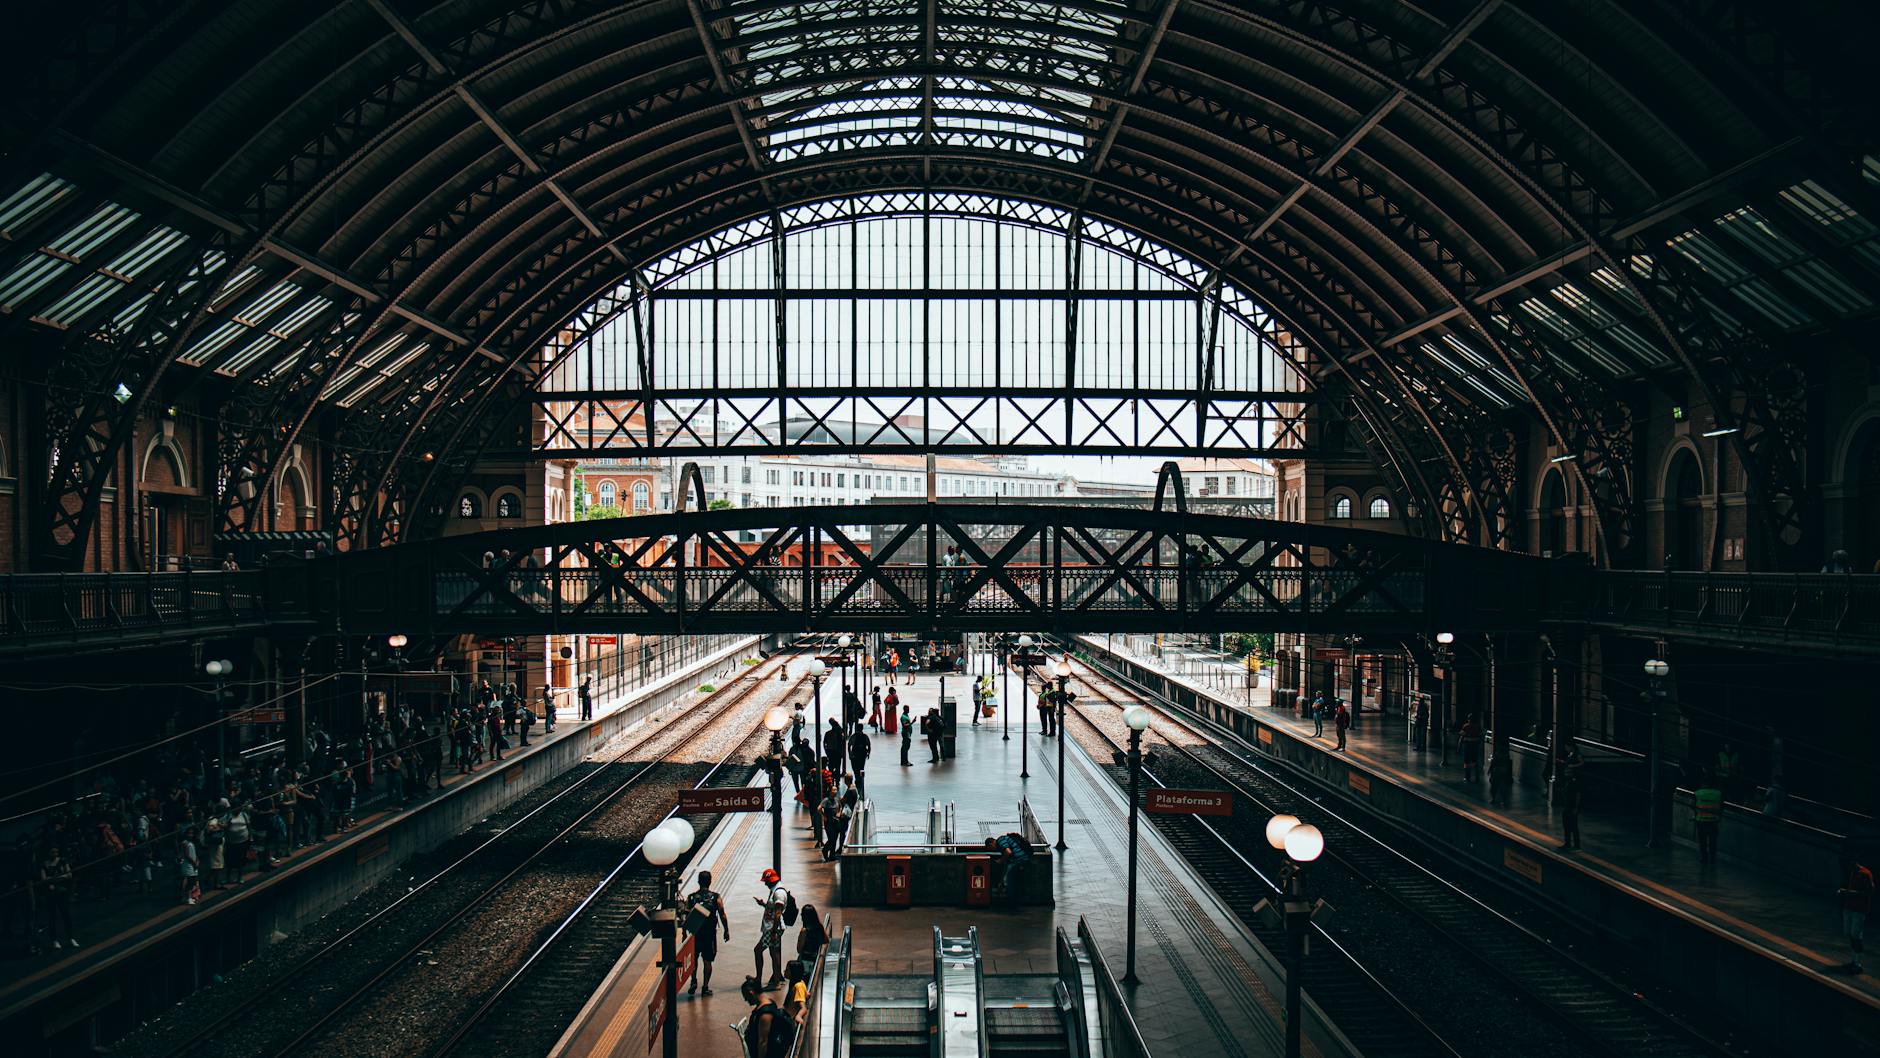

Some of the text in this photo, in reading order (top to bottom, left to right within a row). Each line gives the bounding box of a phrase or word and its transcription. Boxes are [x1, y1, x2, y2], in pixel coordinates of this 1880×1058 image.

[715, 796, 748, 807] Saída
[1156, 795, 1222, 806] Plataforma 3
